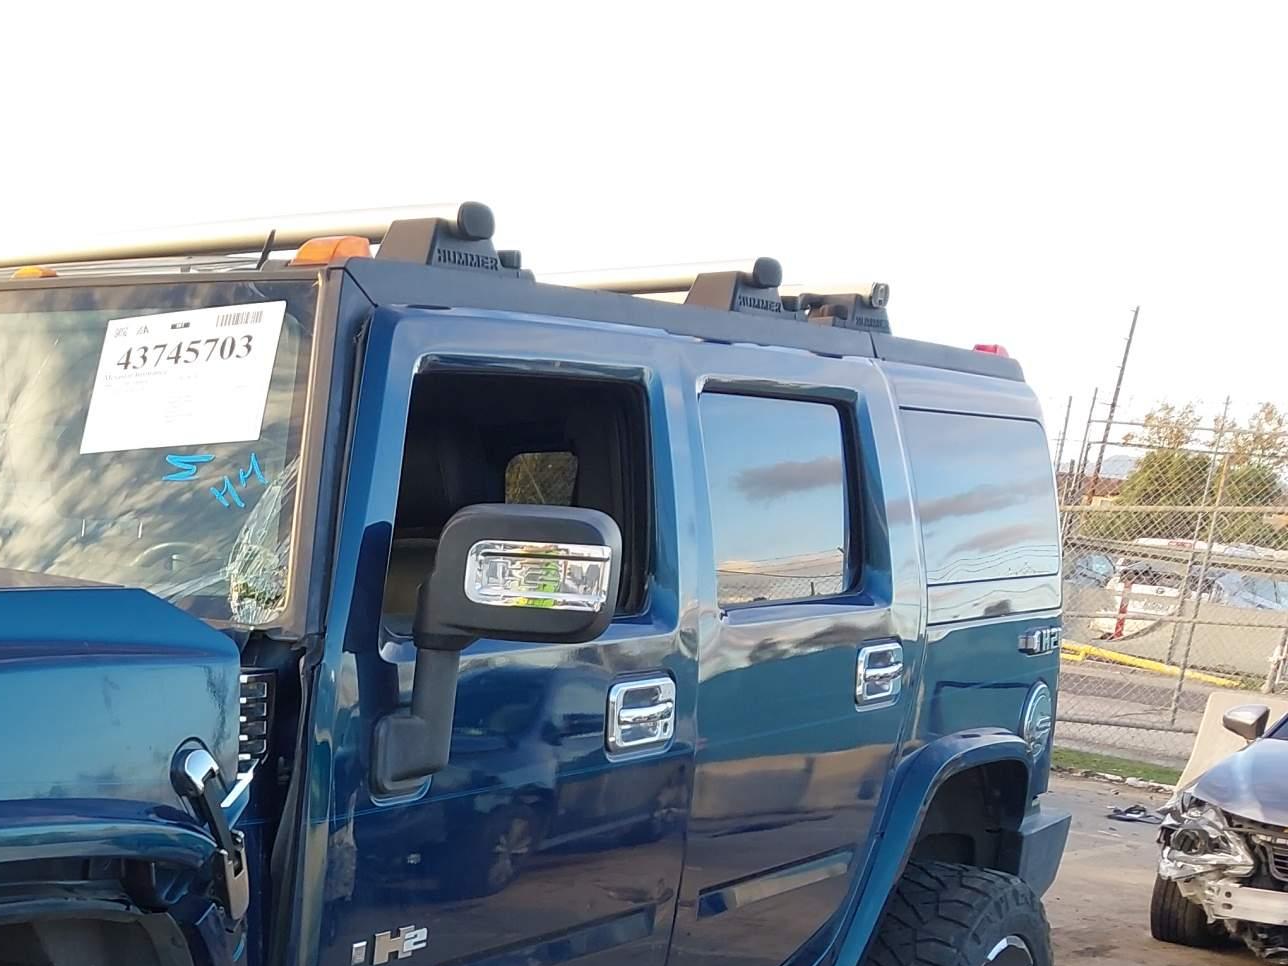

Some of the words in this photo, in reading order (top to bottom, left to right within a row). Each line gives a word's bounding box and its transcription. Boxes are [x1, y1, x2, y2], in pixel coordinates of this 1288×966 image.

[436, 248, 500, 272] HUMMER
[116, 333, 254, 371] 43745703
[372, 924, 428, 966] H2
